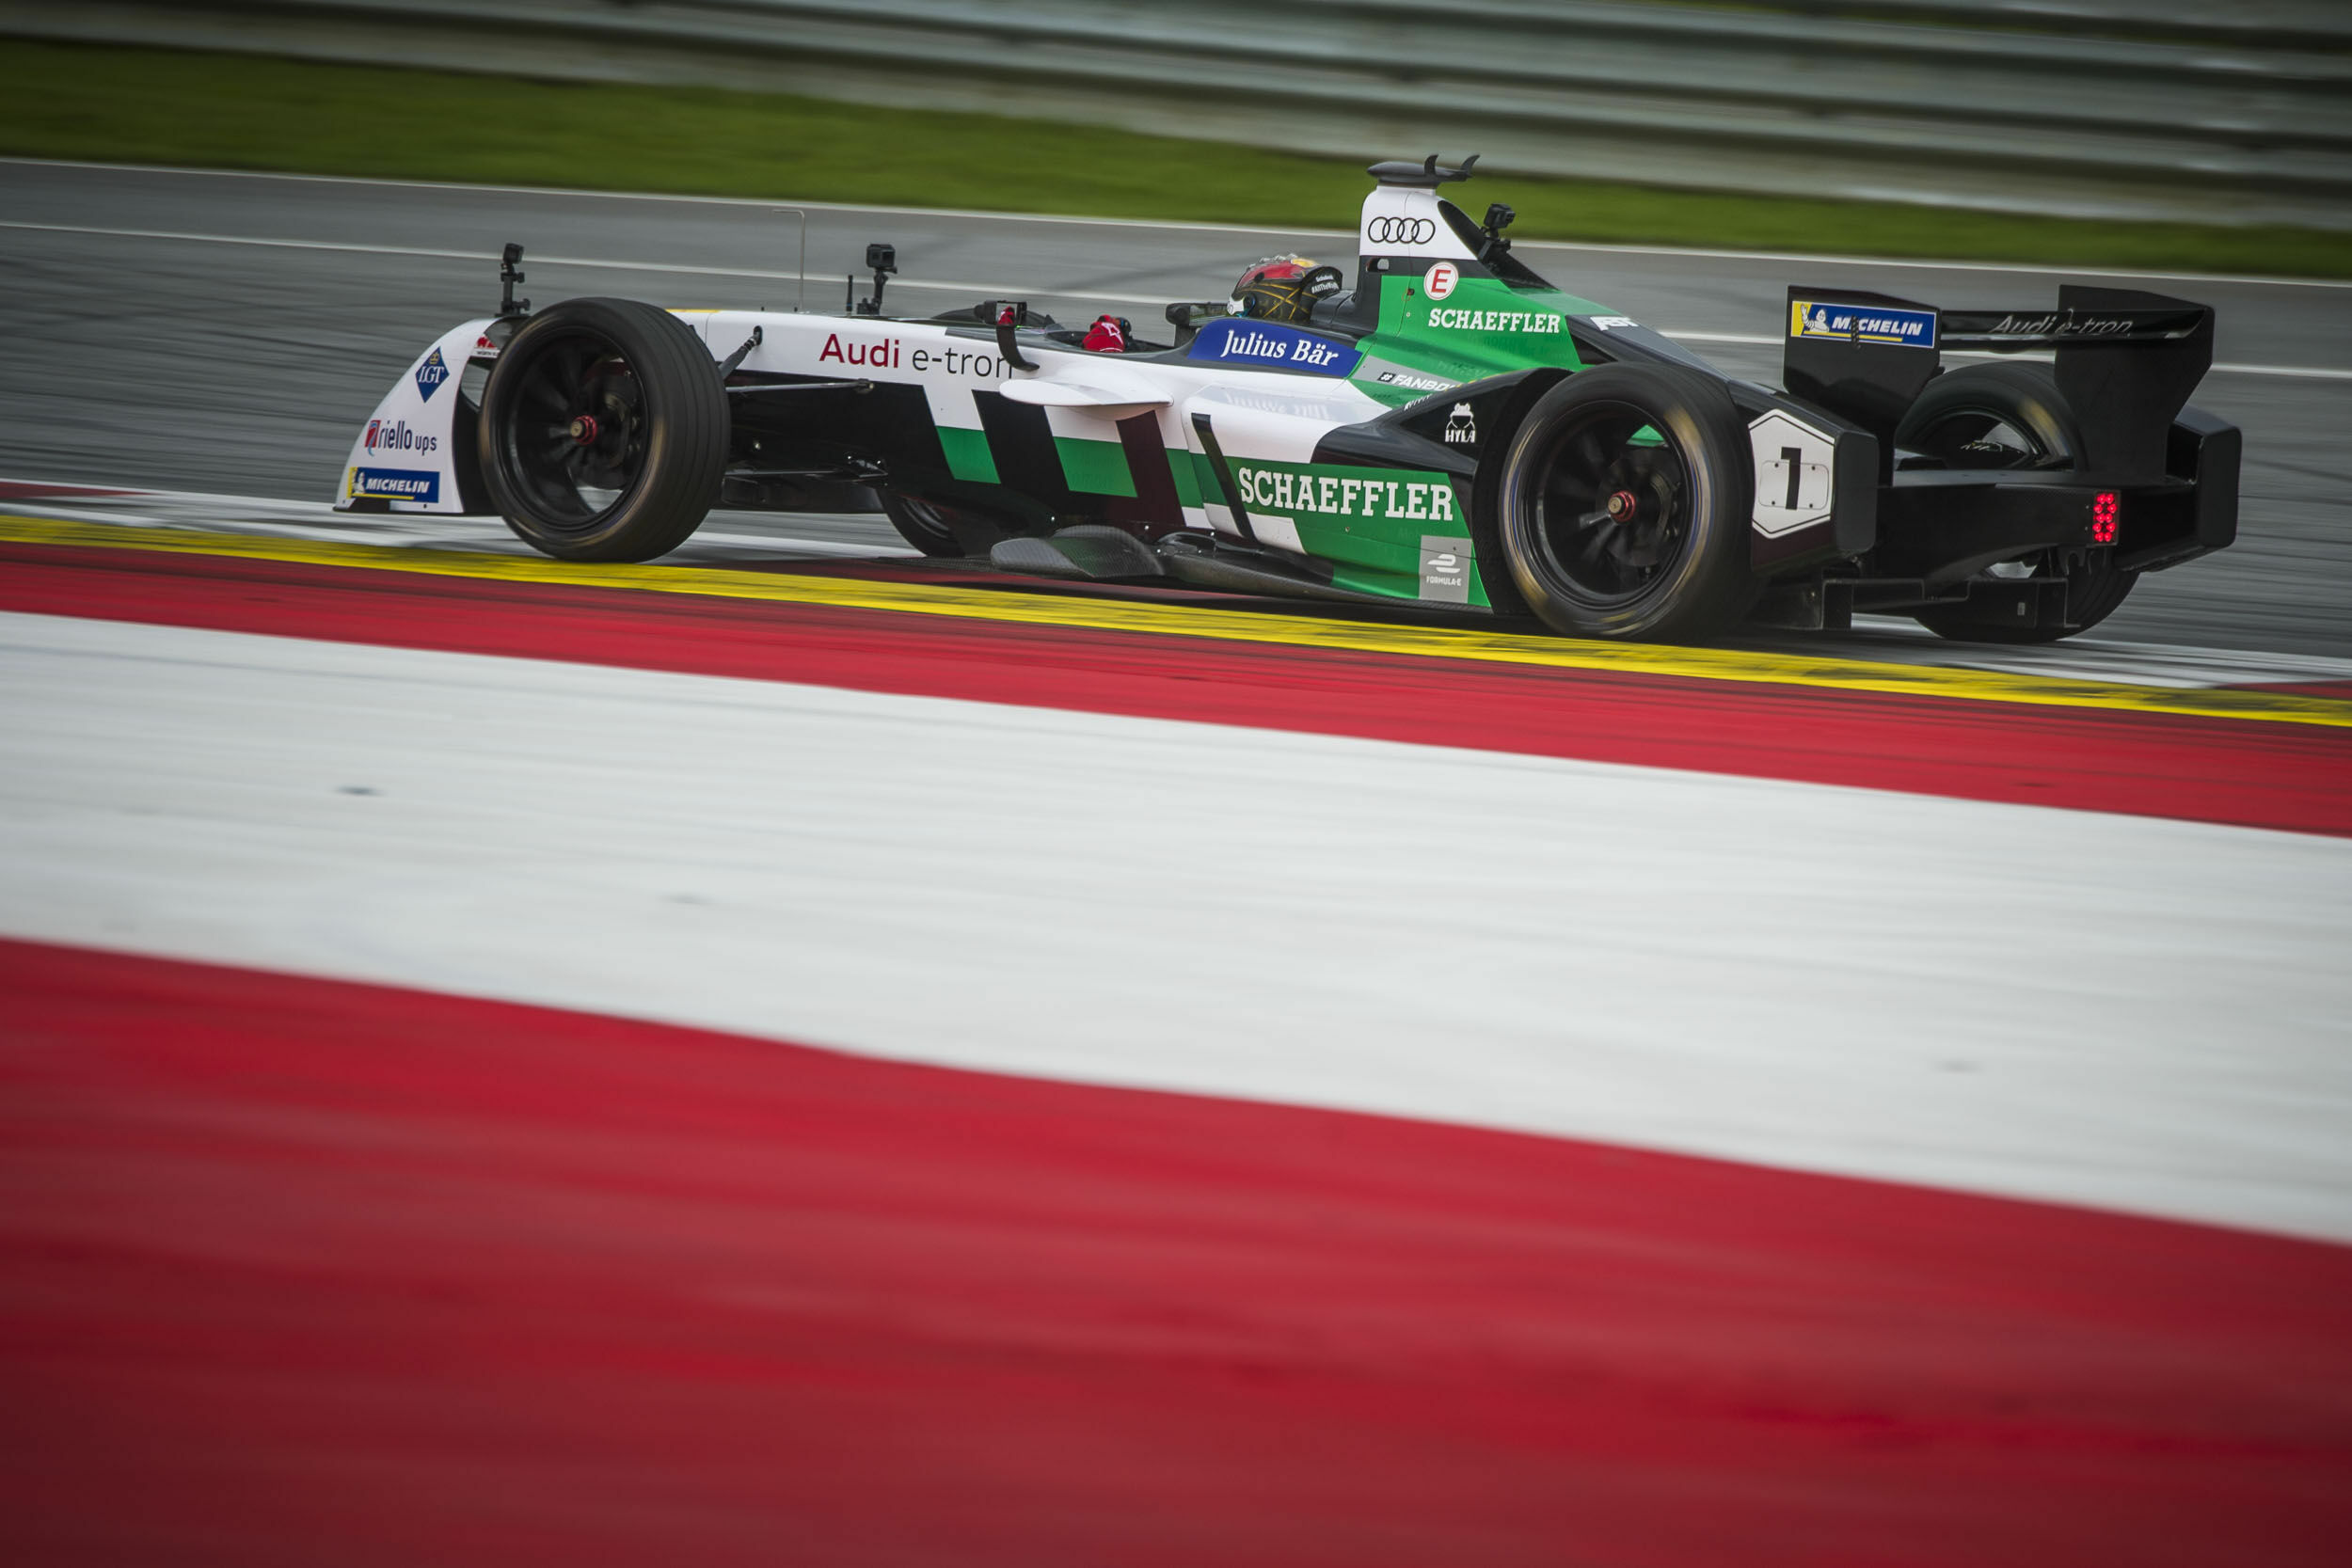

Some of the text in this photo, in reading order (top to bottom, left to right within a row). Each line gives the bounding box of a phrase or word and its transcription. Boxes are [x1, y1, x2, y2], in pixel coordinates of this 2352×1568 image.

[1431, 269, 1452, 293] E
[1428, 308, 1561, 333] SCHAEFFLER
[1832, 316, 1923, 336] MCHELIN
[1989, 314, 2134, 334] Audi e-tron
[819, 333, 1012, 379] Audi e-tron
[1220, 329, 1339, 366] Julius Bär
[418, 366, 445, 384] LGT
[377, 420, 437, 456] riello ups
[1445, 429, 1475, 443] HYLA
[366, 478, 431, 494] MICHELIN
[1781, 446, 1802, 511] 1
[1238, 467, 1454, 521] SCHAEFFLER
